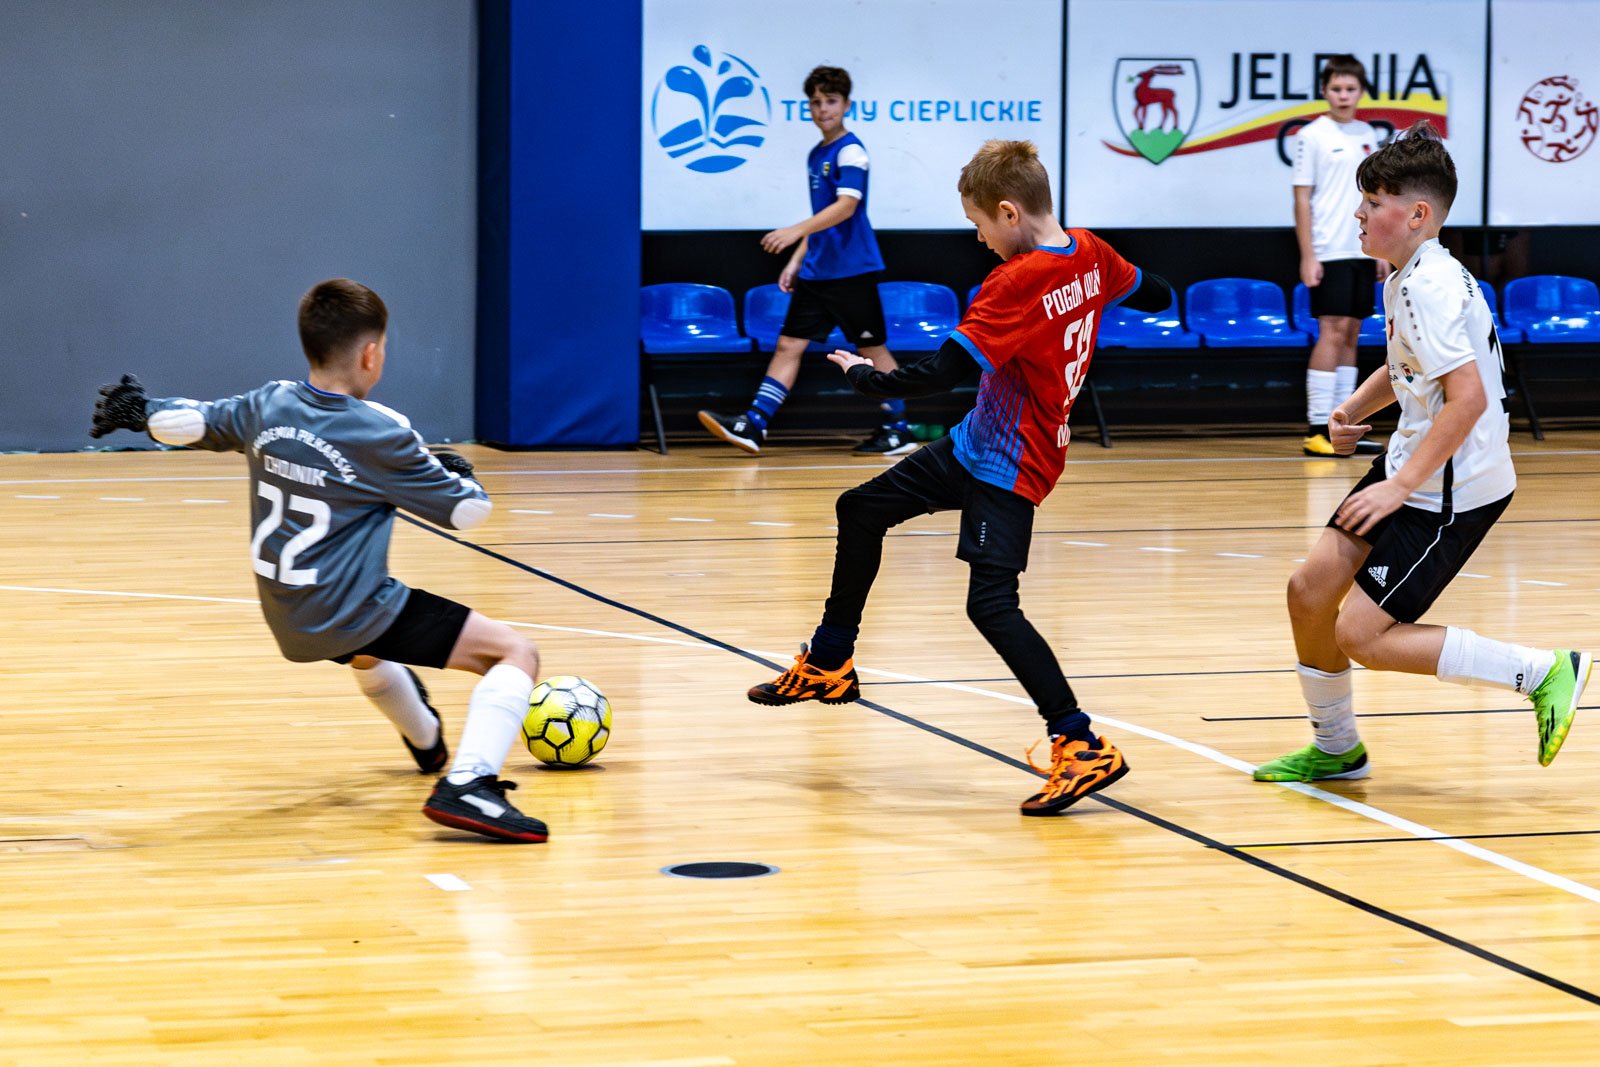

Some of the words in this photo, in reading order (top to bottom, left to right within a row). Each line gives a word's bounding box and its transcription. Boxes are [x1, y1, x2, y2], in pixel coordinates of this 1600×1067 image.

[890, 100, 1041, 121] CIEPLICKIE
[1042, 273, 1084, 320] POGOŃ
[251, 480, 332, 586] 22
[1367, 566, 1387, 588] adidas
